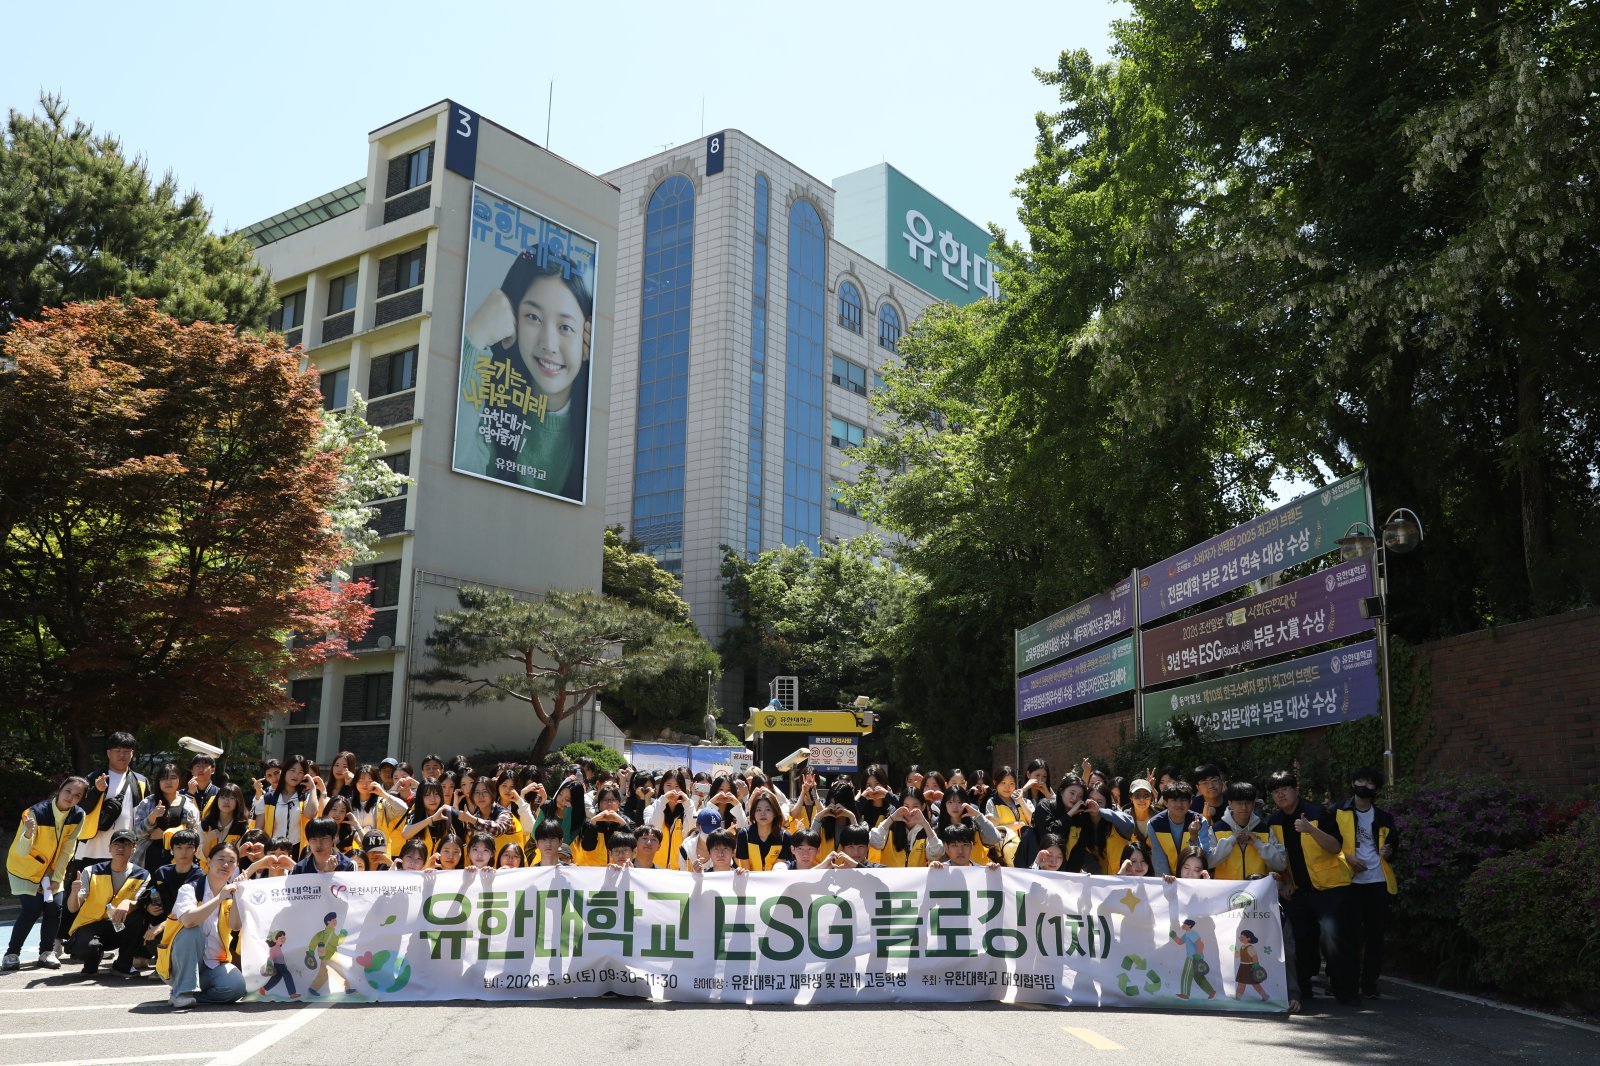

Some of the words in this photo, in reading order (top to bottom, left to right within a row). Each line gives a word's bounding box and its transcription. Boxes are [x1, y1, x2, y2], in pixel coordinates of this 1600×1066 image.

[456, 109, 472, 138] 3
[710, 137, 720, 154] 8
[474, 355, 527, 389] 즐기는
[512, 386, 549, 423] 미래
[479, 407, 531, 435] 유한대가
[495, 457, 547, 480] 유한대학교
[1193, 545, 1216, 567] 소비자가
[1217, 536, 1236, 557] 선택한
[1237, 527, 1257, 548] 2025
[1257, 515, 1279, 538] 최고의
[1279, 505, 1304, 528] 브랜드
[1167, 574, 1200, 605] 전문대학
[1202, 566, 1220, 591] 부문
[1222, 558, 1239, 582] 2년
[1240, 550, 1260, 576] 연속
[1262, 538, 1285, 565] 대상
[1287, 527, 1310, 557] 수상
[1336, 564, 1367, 582] 유한대학교
[1182, 624, 1199, 641] 2026
[1248, 591, 1298, 619] 사회공헌대상
[1167, 650, 1180, 671] 3년
[1181, 646, 1198, 669] 연속
[1254, 624, 1275, 650] 부문
[1276, 616, 1300, 644] 大賞
[1302, 608, 1326, 637] 수상
[1342, 649, 1373, 665] 유한대학교
[1272, 669, 1295, 689] 최고의
[1295, 665, 1320, 684] 브랜드
[780, 716, 813, 724] 유한대학교
[1221, 703, 1260, 731] 전문대학
[1263, 700, 1284, 724] 부문
[1286, 693, 1309, 719] 대상
[1312, 687, 1337, 716] 수상
[369, 836, 384, 845] NY
[270, 885, 322, 896] 유한대학교
[349, 884, 422, 897] 부천시자원봉사센터
[419, 888, 694, 961] 유한대학교
[714, 895, 854, 961] ESG
[1253, 911, 1270, 919] ESG
[547, 973, 559, 986] 5.
[731, 974, 786, 991] 유한대학교
[789, 973, 822, 990] 재학생
[825, 973, 837, 989] 및
[839, 972, 862, 989] 관내
[864, 972, 907, 989] 고등학생
[921, 974, 941, 986] 주최:
[944, 970, 998, 987] 유한대학교
[1001, 971, 1056, 990] 대외협력팀
